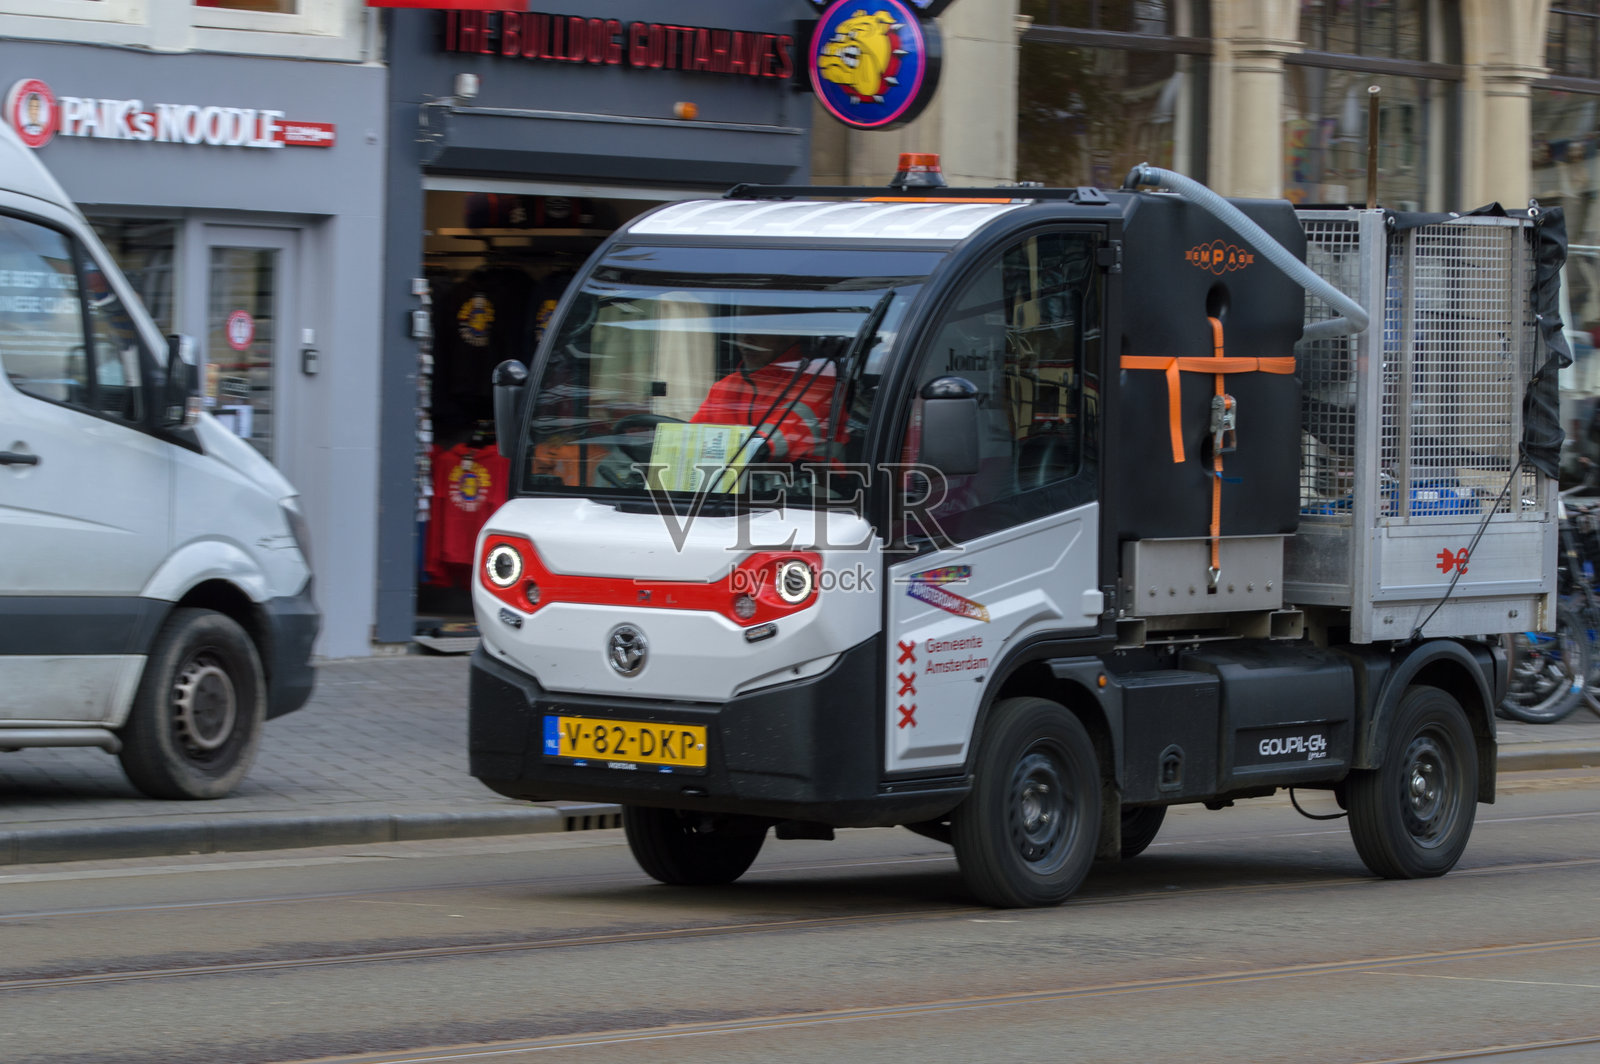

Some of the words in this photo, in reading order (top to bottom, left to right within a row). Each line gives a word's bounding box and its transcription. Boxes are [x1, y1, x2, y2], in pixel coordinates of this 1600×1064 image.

[445, 10, 496, 54] THE
[501, 11, 623, 64] BULLDOG
[629, 22, 794, 79] GOTTAHAVES
[153, 103, 286, 149] NOODLE
[926, 637, 983, 654] Gemeente
[926, 655, 988, 674] Amsterdam
[565, 722, 697, 760] V-82-DKP
